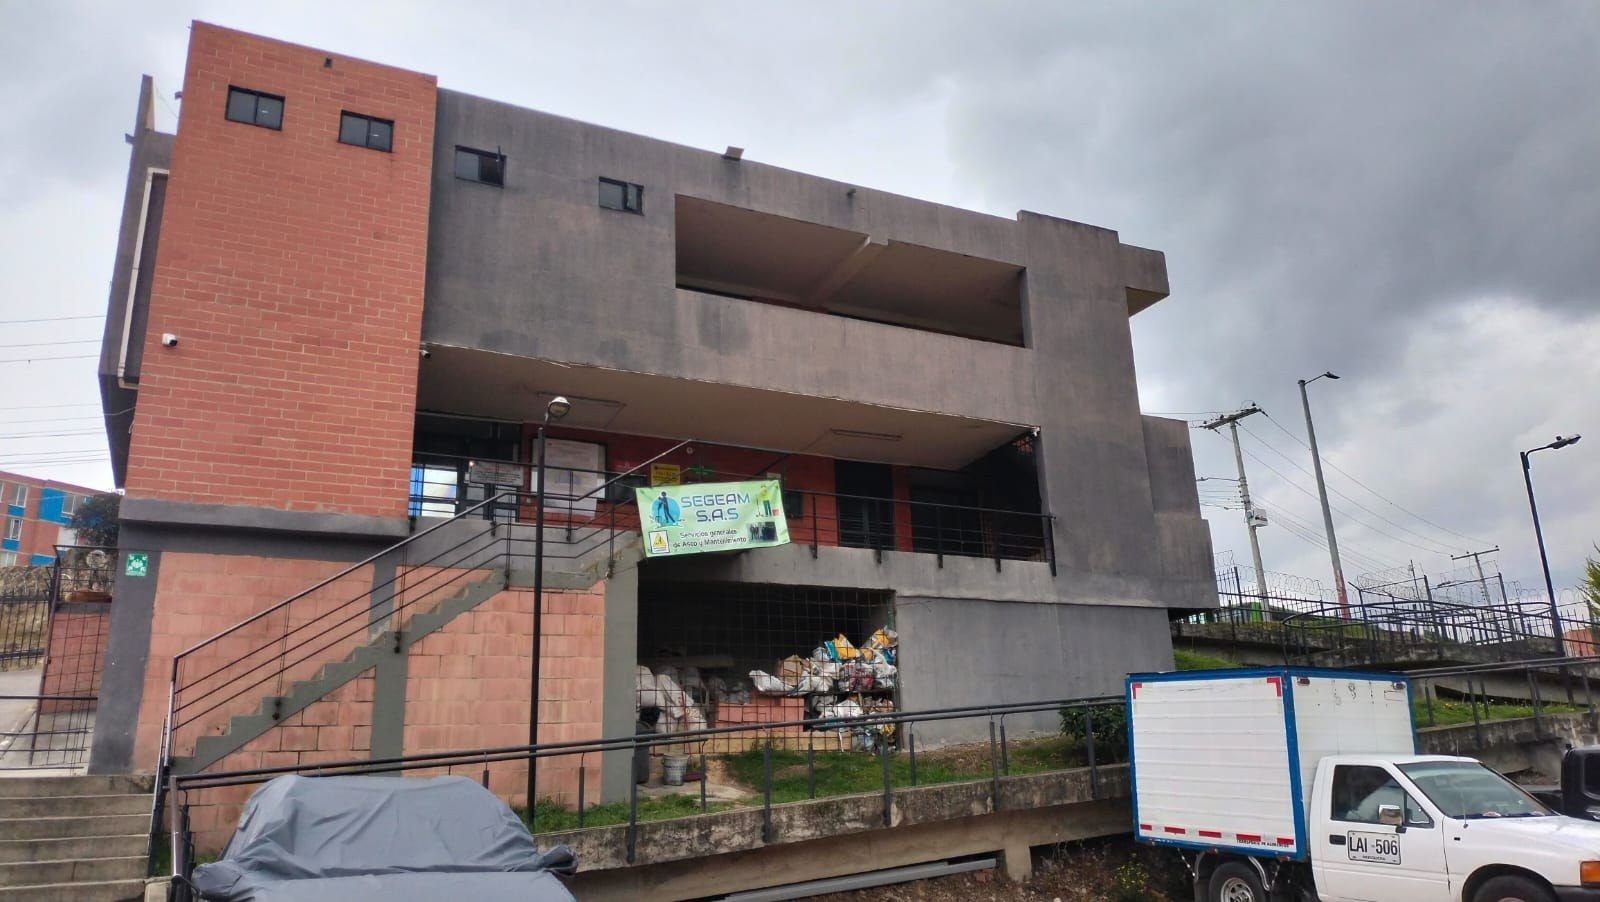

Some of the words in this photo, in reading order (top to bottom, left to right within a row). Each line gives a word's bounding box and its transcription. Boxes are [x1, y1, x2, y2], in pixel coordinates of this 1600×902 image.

[681, 492, 751, 508] SEGEAM
[696, 507, 739, 523] S.A.S
[1349, 836, 1368, 853] LAI
[1375, 838, 1398, 856] 506
